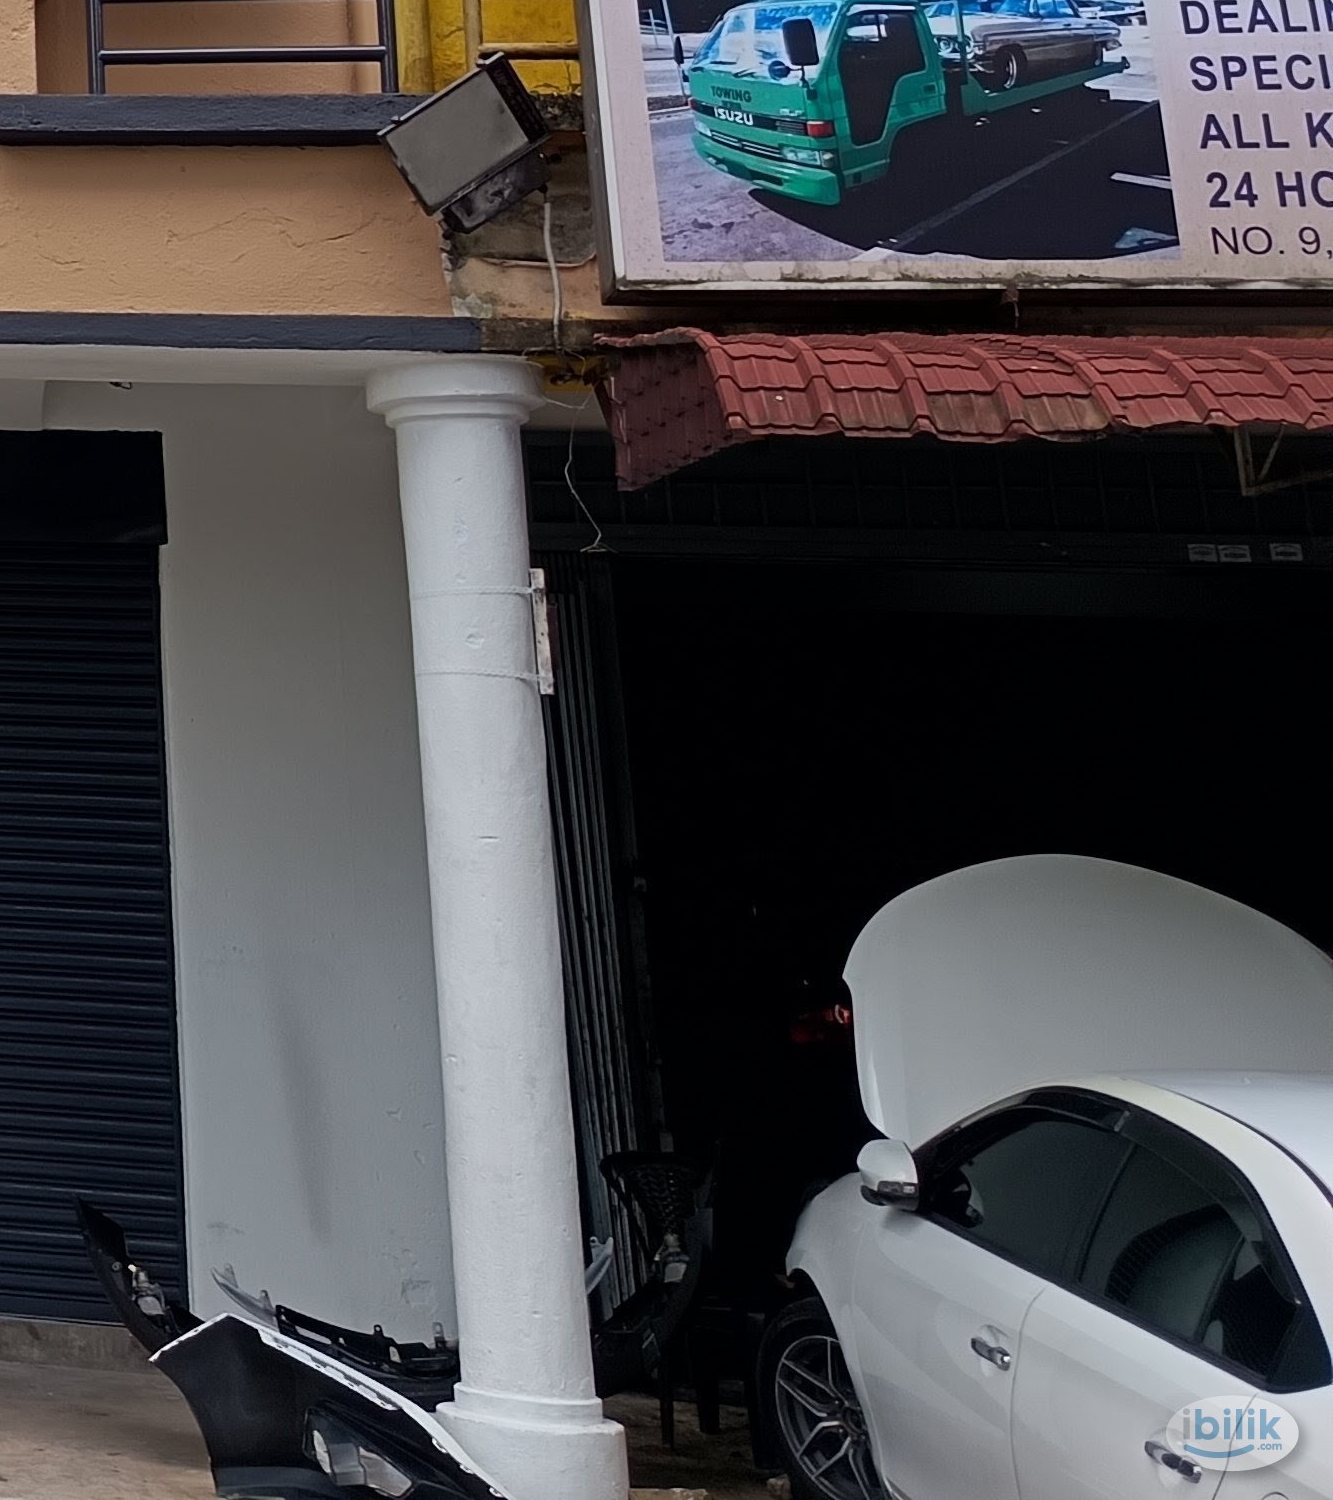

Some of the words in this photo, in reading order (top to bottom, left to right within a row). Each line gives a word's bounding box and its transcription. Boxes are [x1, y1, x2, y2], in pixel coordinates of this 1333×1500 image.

[710, 85, 753, 102] TOWING
[713, 105, 754, 126] ISUZU
[1199, 113, 1290, 149] ALL
[1206, 171, 1258, 208] 24
[1210, 226, 1285, 255] NO.
